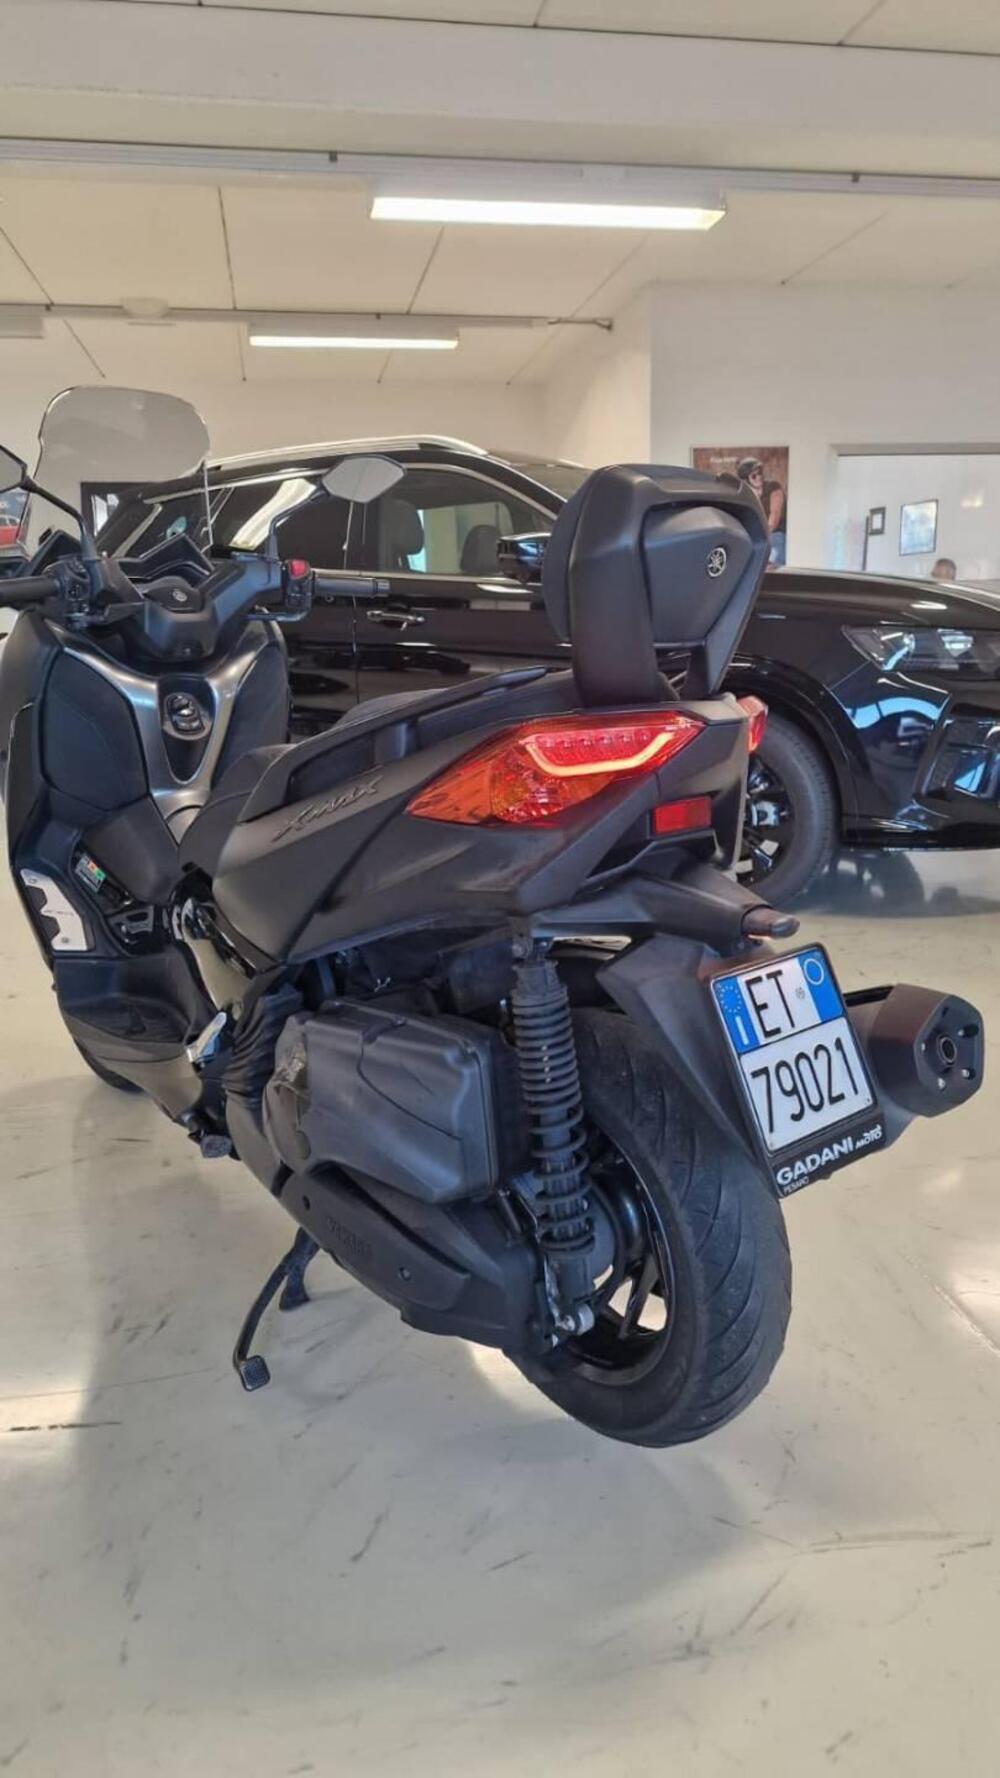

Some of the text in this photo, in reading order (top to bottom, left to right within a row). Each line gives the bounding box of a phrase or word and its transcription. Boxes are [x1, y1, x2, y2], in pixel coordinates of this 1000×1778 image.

[746, 970, 795, 1038] ET
[751, 1036, 859, 1134] 79021
[777, 1136, 853, 1186] GADANI
